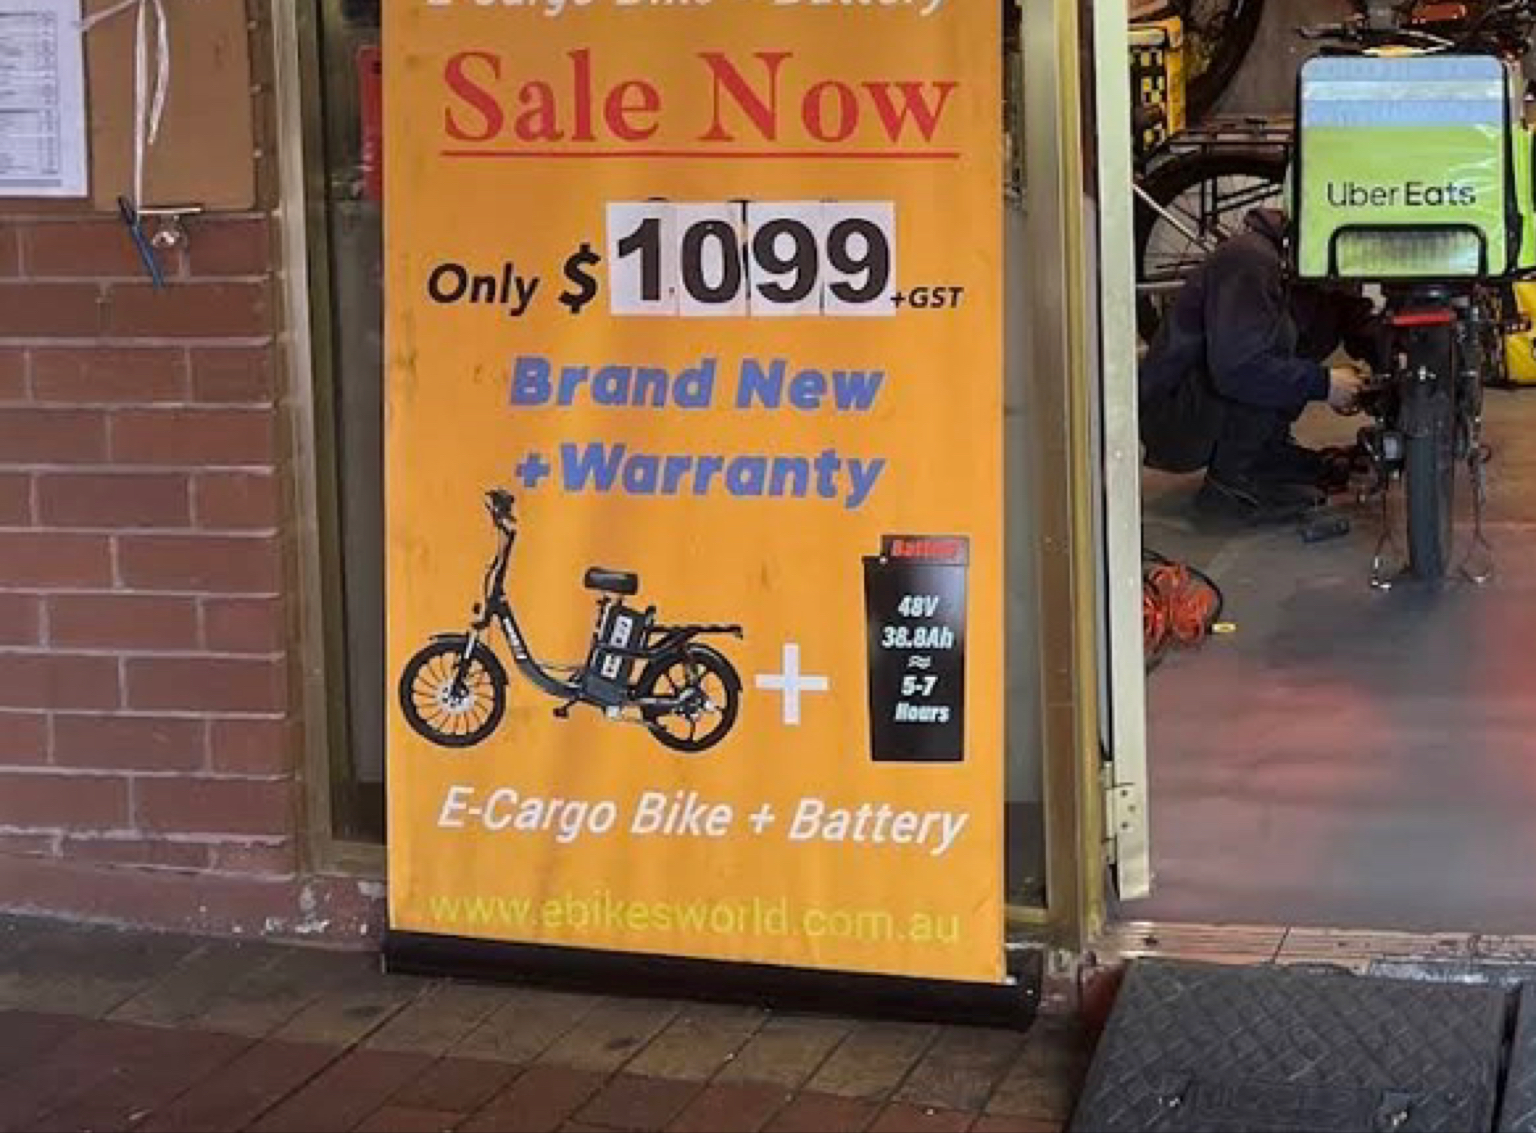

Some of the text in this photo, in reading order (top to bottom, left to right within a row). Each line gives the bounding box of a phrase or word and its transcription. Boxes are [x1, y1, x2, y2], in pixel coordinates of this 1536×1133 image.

[443, 47, 960, 144] Sale Now
[1327, 182, 1477, 207] Uber Eats
[427, 263, 540, 317] Only
[890, 286, 965, 310] +GST
[510, 357, 885, 412] Brand New
[515, 443, 885, 509] +Warranty
[898, 595, 940, 617] 48V
[882, 626, 954, 649] 38.8Ah
[894, 702, 950, 723] Hours
[901, 676, 937, 696] 5-7
[437, 785, 617, 842] E-Cargo
[630, 791, 733, 837] Bike
[789, 798, 967, 855] Battery
[428, 890, 961, 943] www.ebikesworld.com.au
